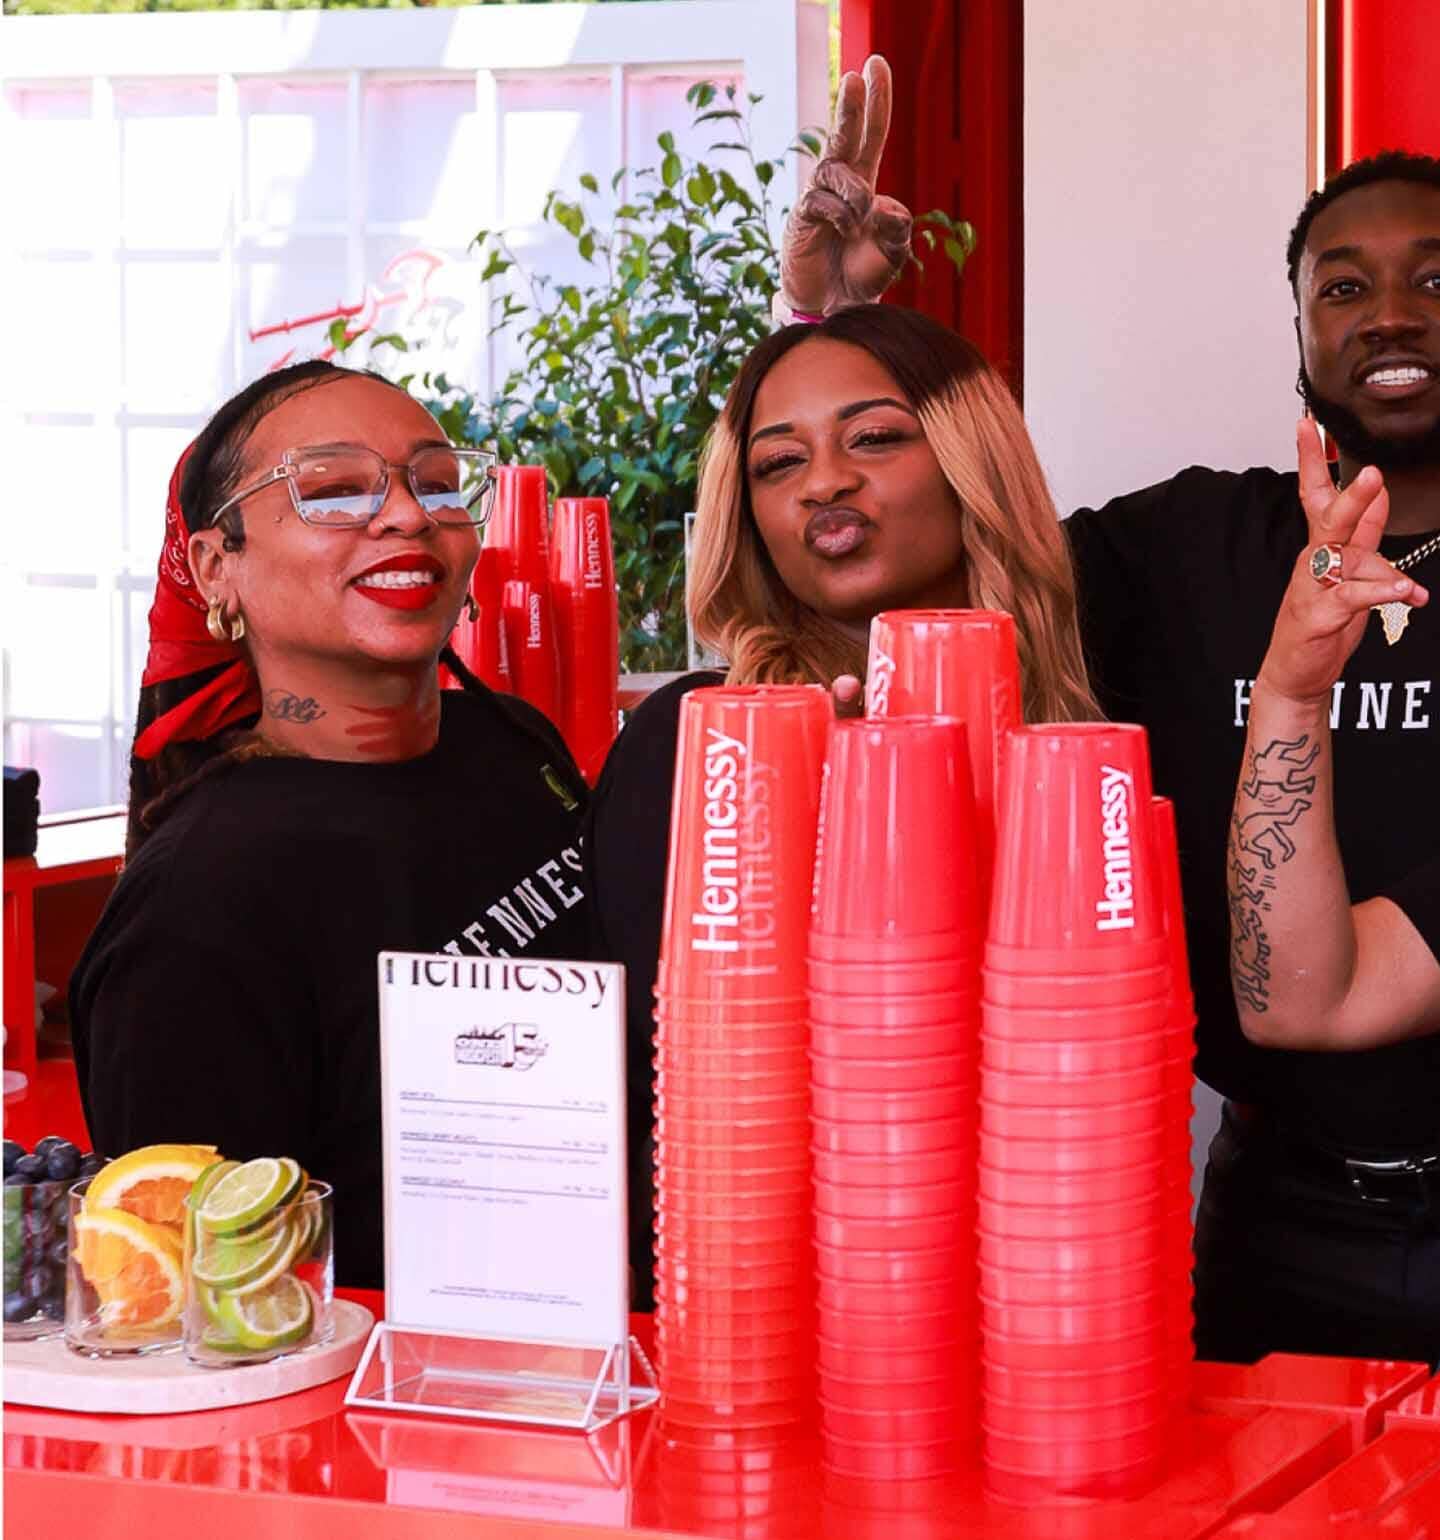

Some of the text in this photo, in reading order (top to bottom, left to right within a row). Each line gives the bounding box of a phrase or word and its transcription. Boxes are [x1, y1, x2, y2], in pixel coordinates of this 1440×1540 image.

[584, 511, 603, 589] Hennessy
[691, 727, 747, 952] Hennessy
[1096, 765, 1135, 931] Hennessy
